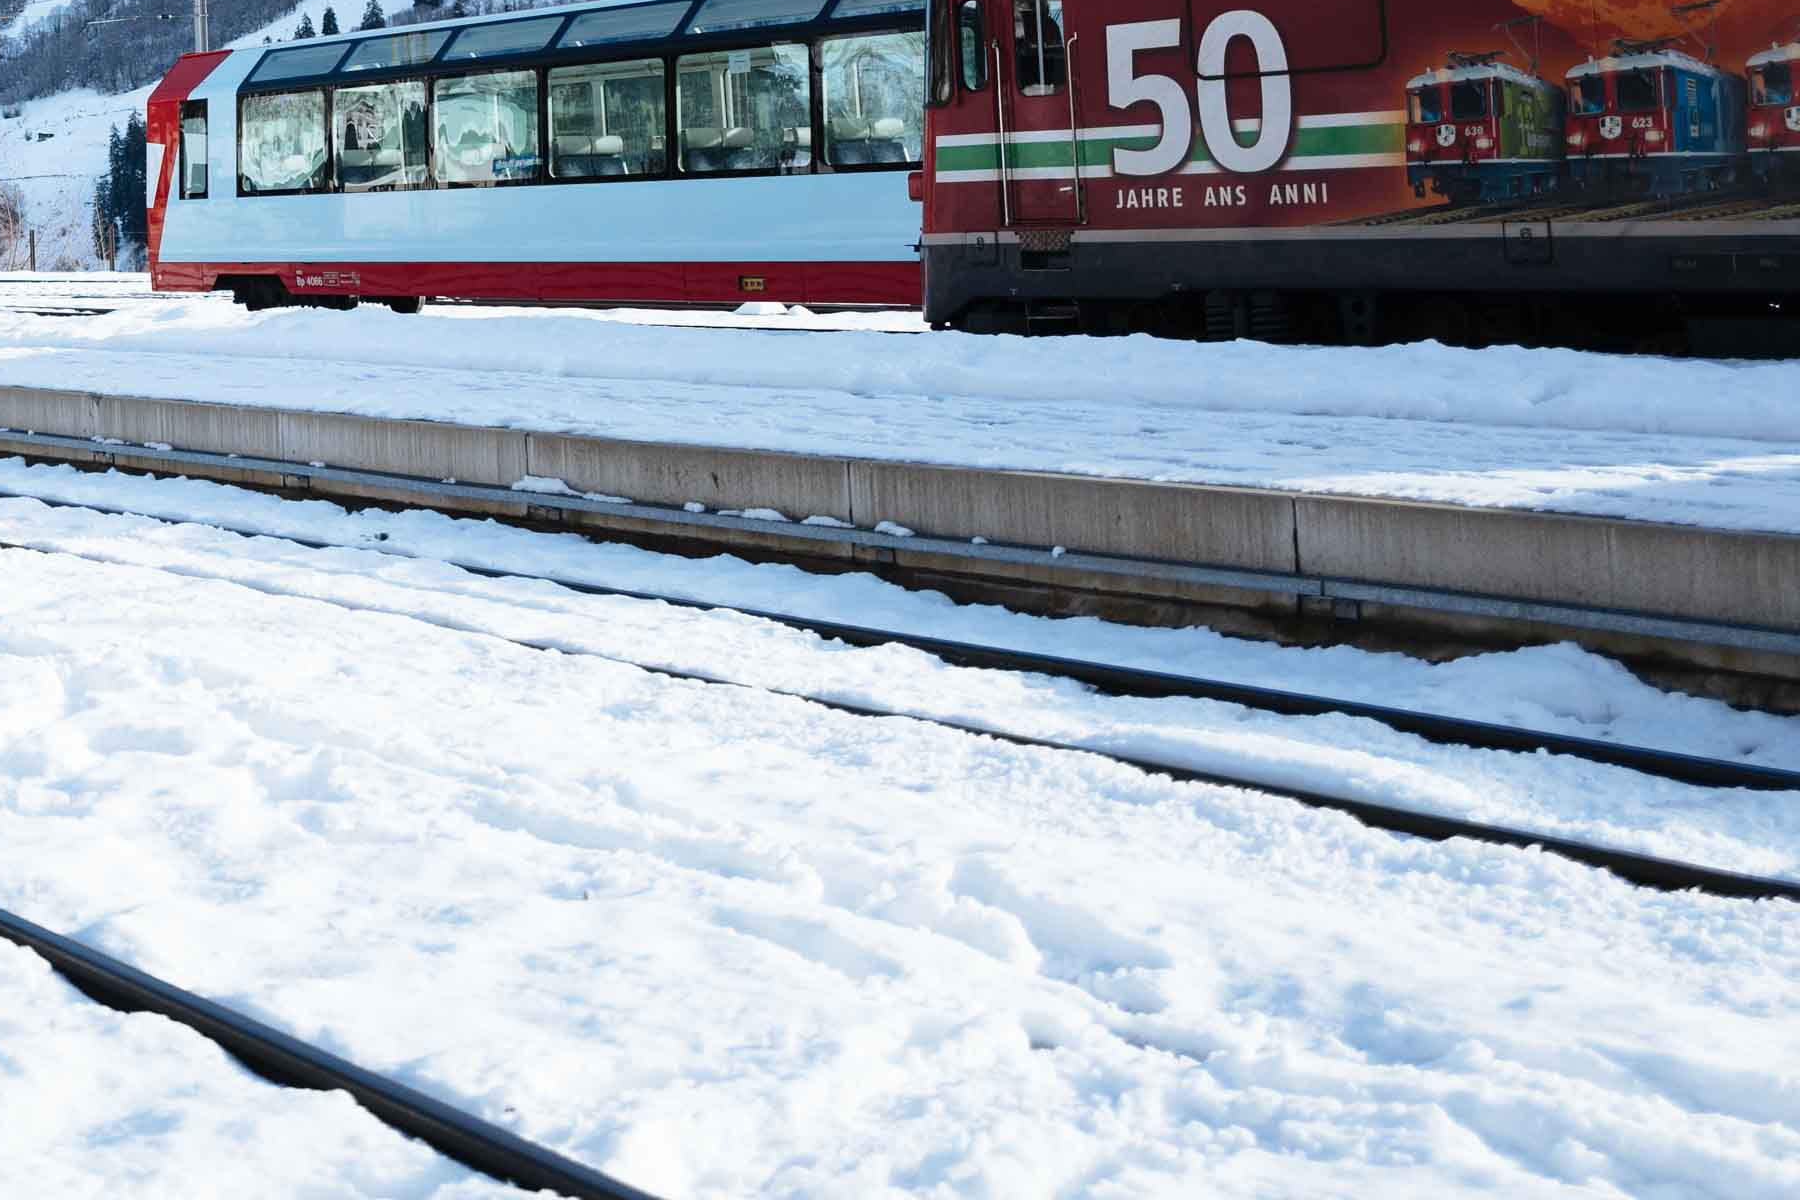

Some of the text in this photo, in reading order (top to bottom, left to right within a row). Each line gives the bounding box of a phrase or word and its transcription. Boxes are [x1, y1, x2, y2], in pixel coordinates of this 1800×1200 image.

[1105, 9, 1292, 176] 50
[1631, 115, 1654, 128] 623
[1115, 183, 1328, 209] JAHRE ANS ANNI
